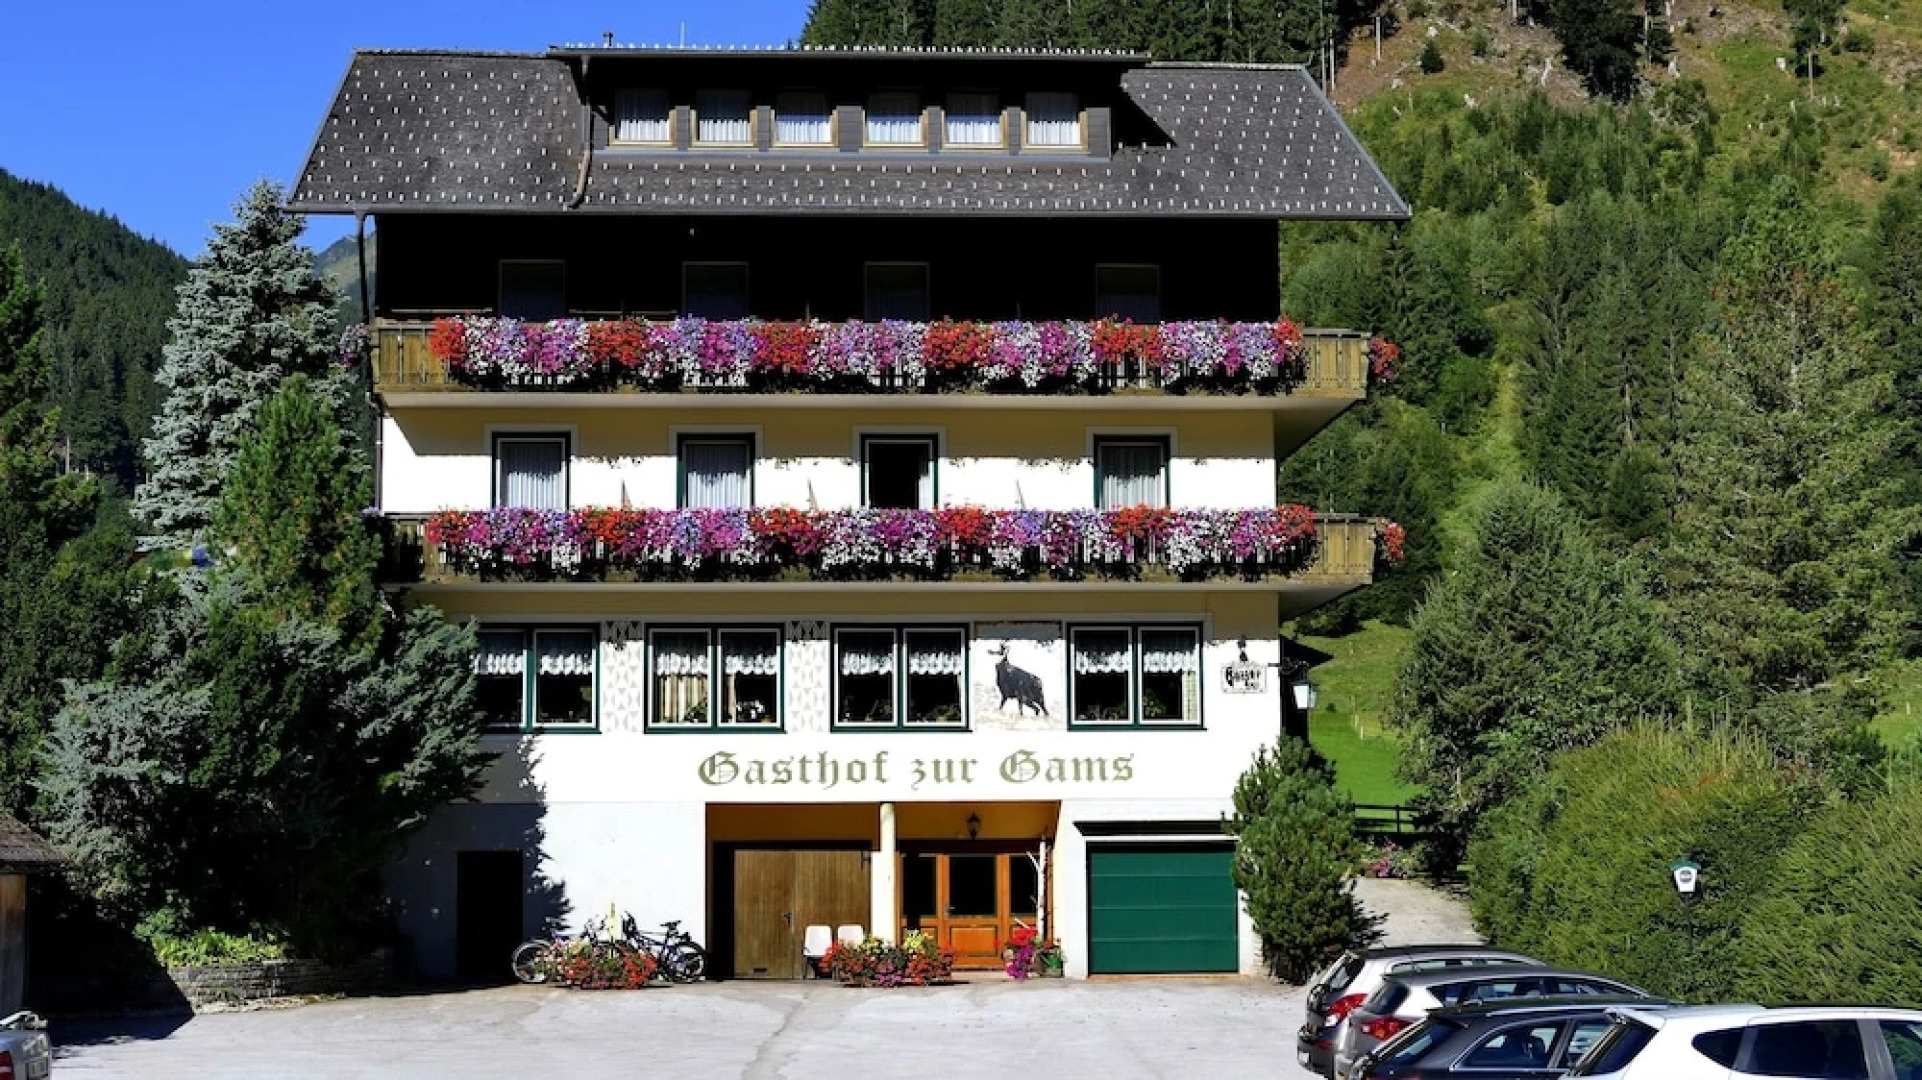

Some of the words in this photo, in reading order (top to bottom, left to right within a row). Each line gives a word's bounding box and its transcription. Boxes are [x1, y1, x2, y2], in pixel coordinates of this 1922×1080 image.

[698, 750, 888, 790] Gasthof
[911, 758, 977, 790] zur
[999, 749, 1135, 784] Gams
